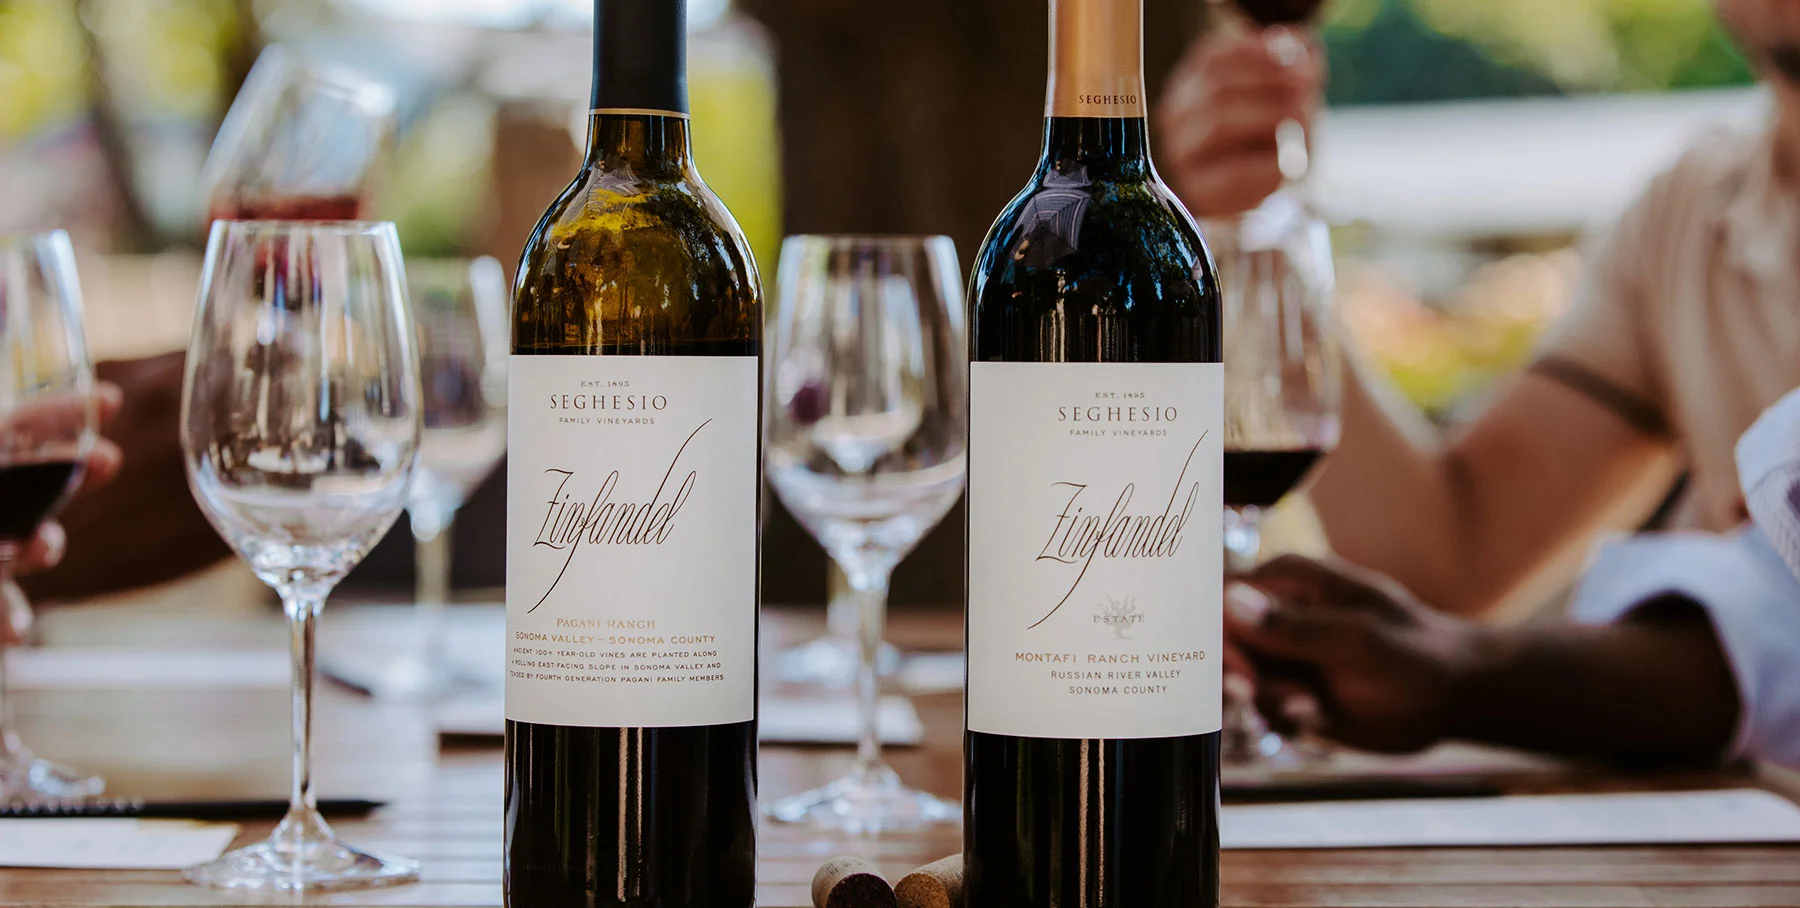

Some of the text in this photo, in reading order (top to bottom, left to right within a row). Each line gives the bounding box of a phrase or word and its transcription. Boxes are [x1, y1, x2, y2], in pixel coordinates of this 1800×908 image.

[1078, 94, 1137, 104] SEGHESIO
[550, 394, 667, 411] SEGHESIO
[1058, 406, 1178, 422] SEGHESIO
[559, 417, 655, 425] FAMILY VINEYARDS
[1069, 429, 1167, 437] FAMILY VINEYARDS
[527, 418, 713, 614] Zinfandel
[1026, 428, 1209, 630] Zinfandel
[557, 618, 655, 629] PAGANI RANCH
[1093, 615, 1145, 623] ESTATE
[515, 631, 548, 642] SONOMA
[551, 634, 595, 644] VALLEY
[608, 635, 665, 645] SONOMA
[670, 635, 716, 645] COUNTY
[535, 649, 553, 657] 100+
[556, 650, 596, 658] YEAR-OLD
[1015, 650, 1205, 664] MONTAFI RANCH VINEYARD
[538, 661, 585, 670] EAST-FACING
[588, 663, 617, 671] SLOPE
[620, 663, 630, 671] IN
[633, 663, 671, 671] SONOMA
[674, 662, 704, 670] VALLEY
[526, 672, 534, 680] BY
[535, 673, 562, 681] FOURTH
[564, 674, 617, 683] GENERATION
[620, 675, 653, 683] PAGANI
[688, 673, 724, 682] MEMBERS
[1050, 669, 1181, 680] RUSSIAN RIVER VALLEY
[1069, 684, 1167, 694] SONOMA COUNTY
